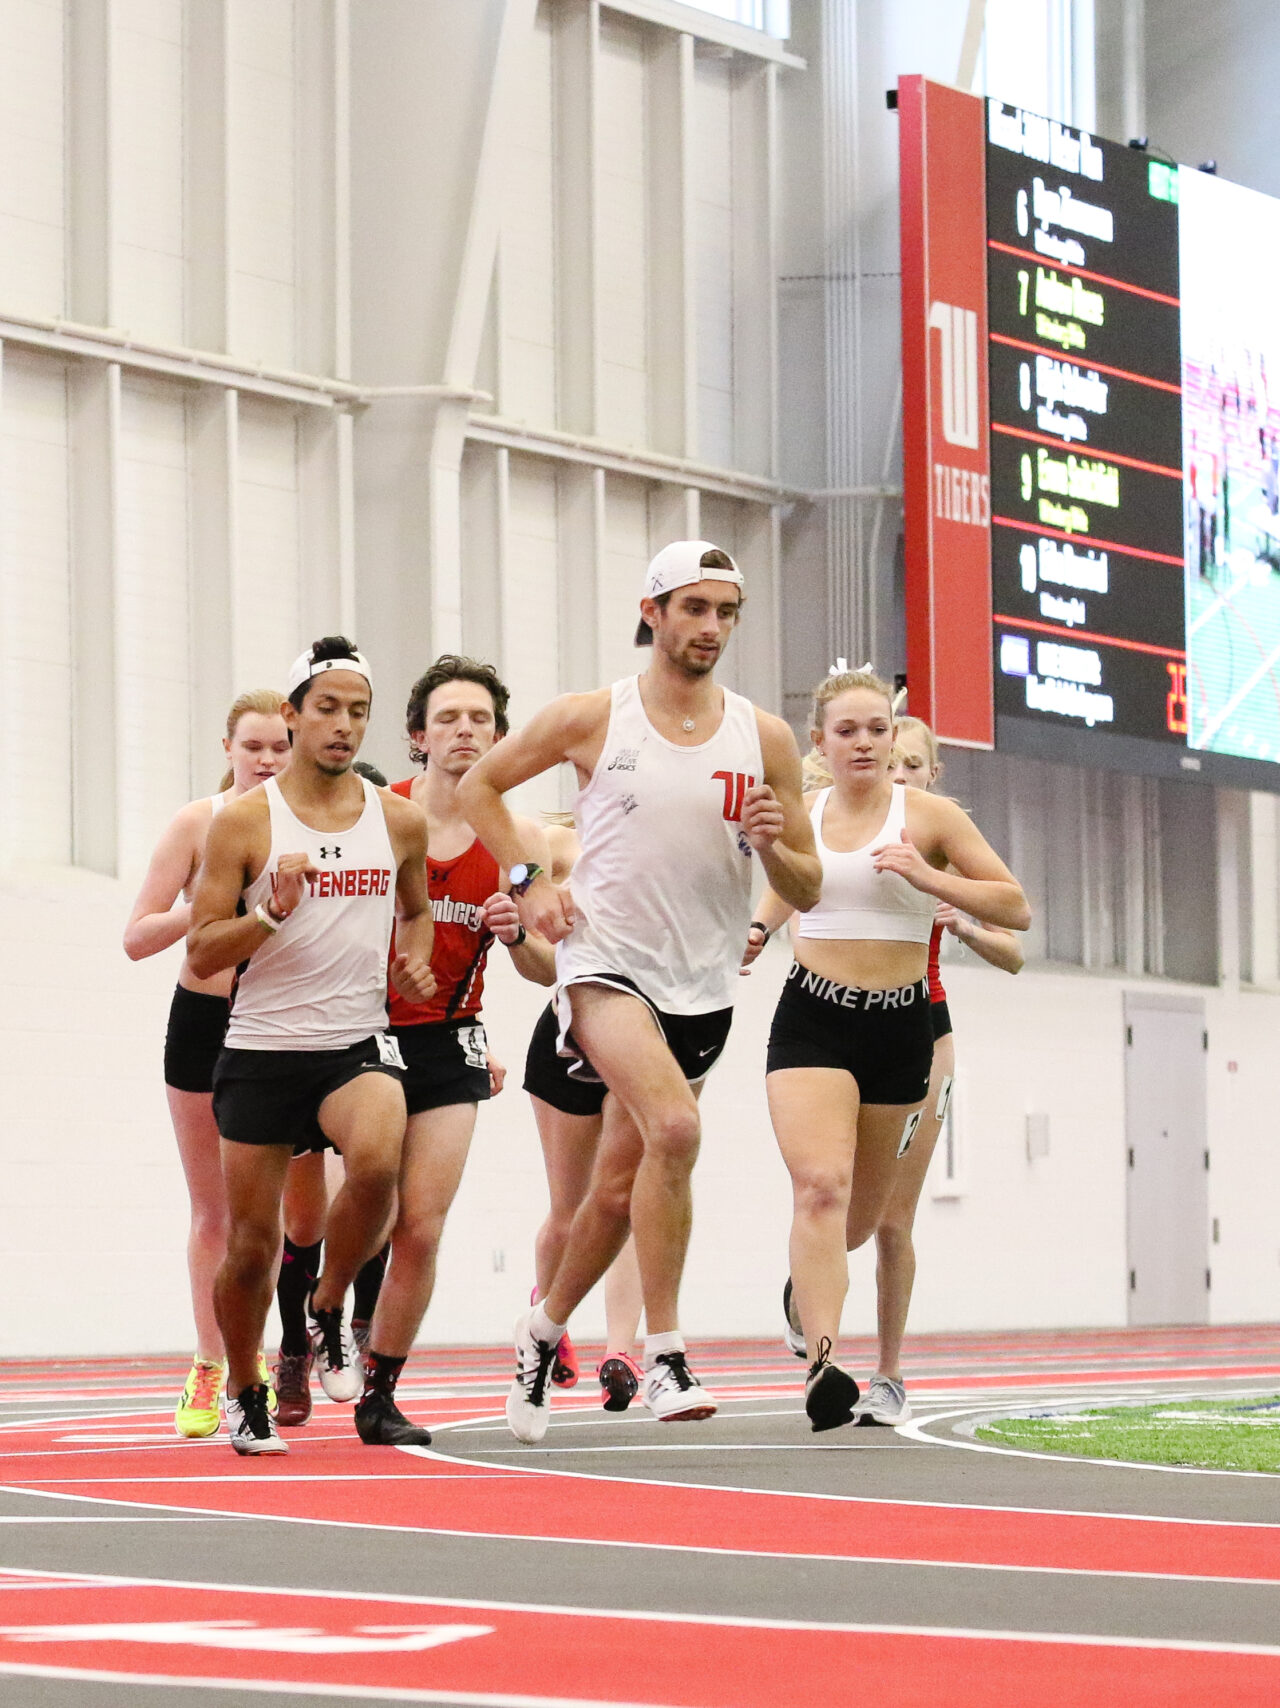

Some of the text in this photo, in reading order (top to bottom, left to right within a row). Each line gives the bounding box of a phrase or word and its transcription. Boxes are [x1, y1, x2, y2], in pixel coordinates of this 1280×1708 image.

[935, 463, 990, 528] TIGERS
[270, 868, 391, 898] TENBERG
[429, 894, 484, 932] nberg
[801, 970, 862, 1009] NIKE
[863, 984, 915, 1011] PRO
[898, 1113, 920, 1157] 2
